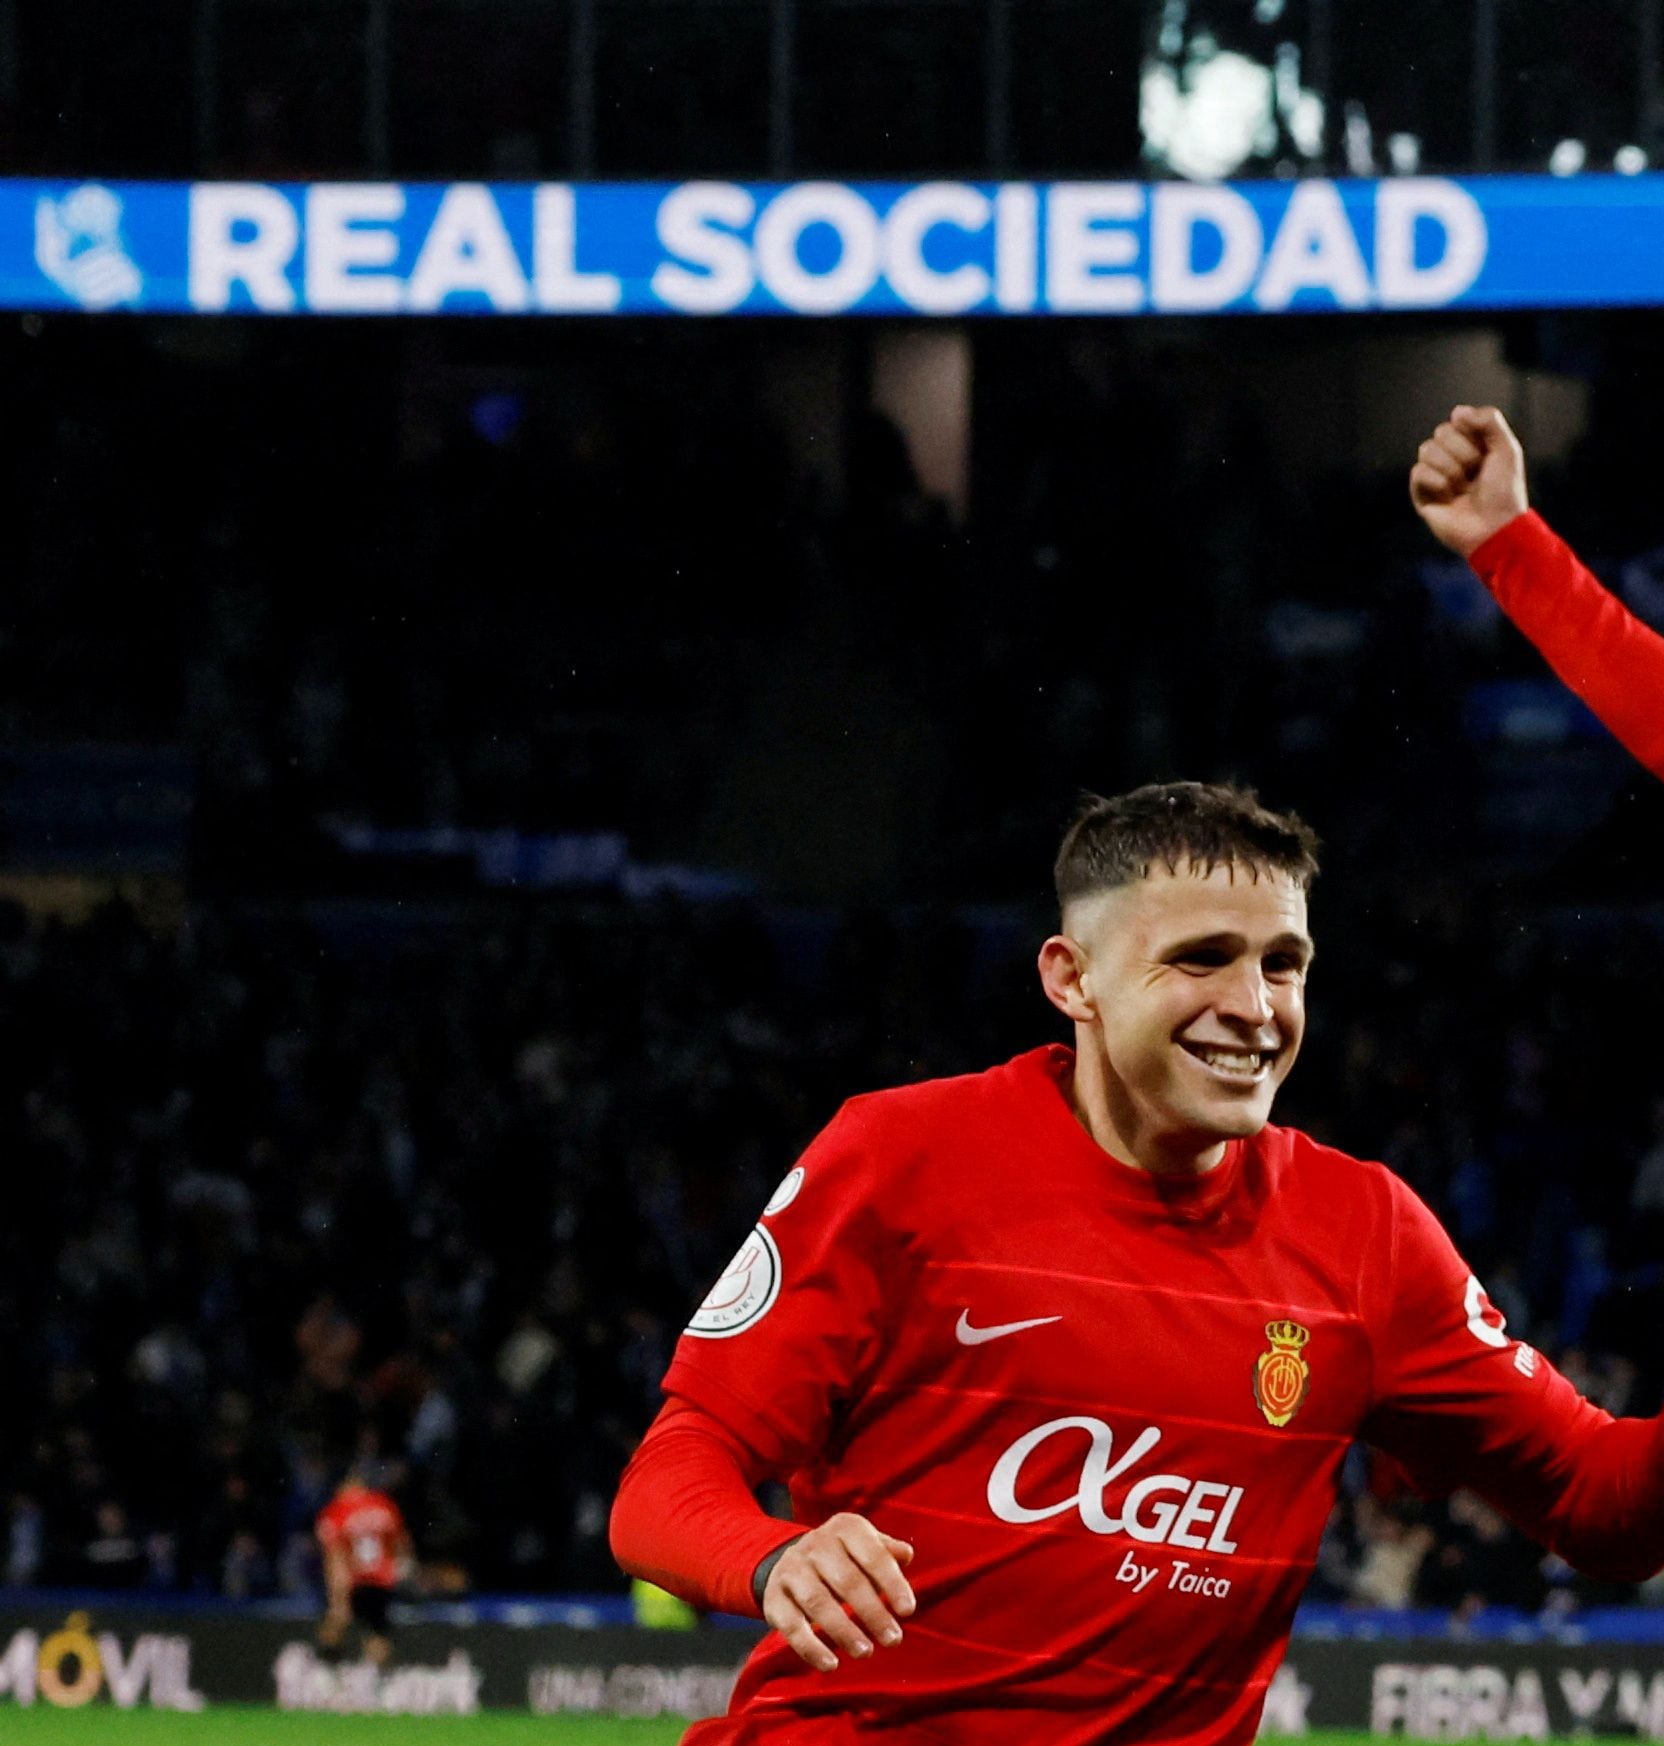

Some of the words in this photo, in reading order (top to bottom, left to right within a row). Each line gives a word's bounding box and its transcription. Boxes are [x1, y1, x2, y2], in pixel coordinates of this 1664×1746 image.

[189, 182, 619, 311] REAL
[653, 180, 1486, 312] SOCIEDAD
[1115, 1551, 1159, 1593] by
[1167, 1560, 1232, 1599] Taica
